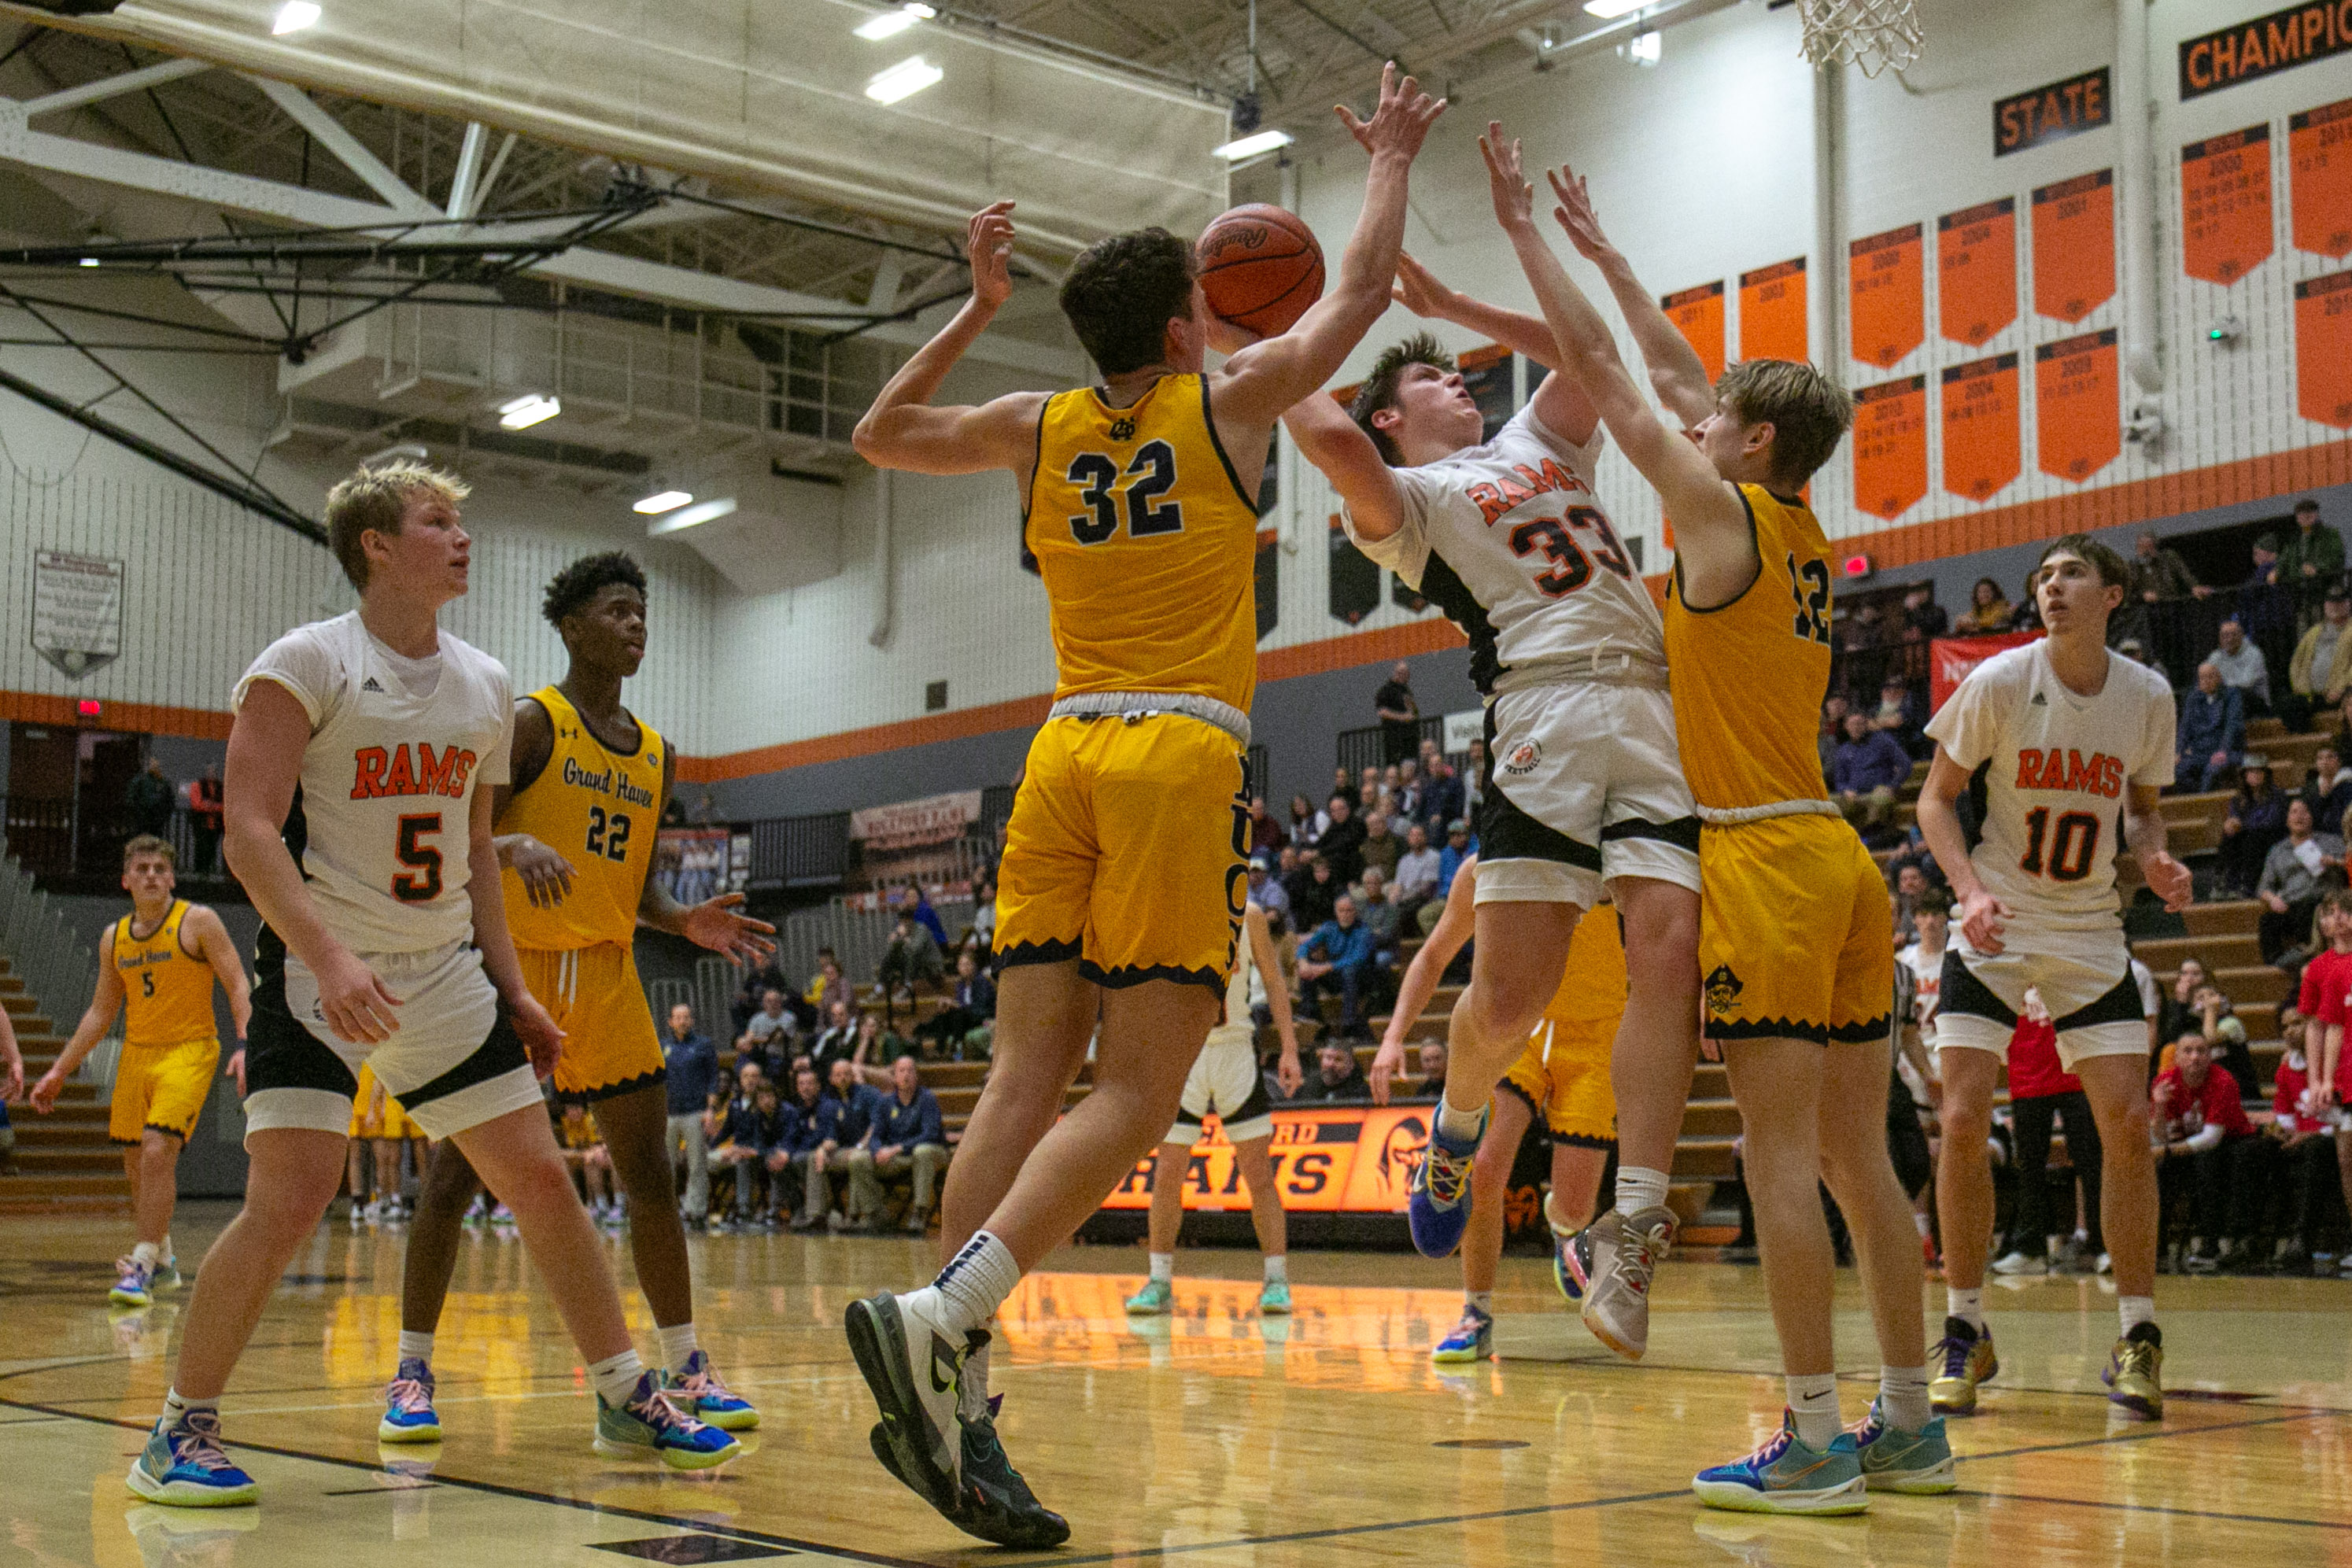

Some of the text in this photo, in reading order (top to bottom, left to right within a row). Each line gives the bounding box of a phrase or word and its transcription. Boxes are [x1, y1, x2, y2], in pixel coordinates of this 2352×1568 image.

[2001, 79, 2102, 148] STATE
[1066, 437, 1184, 548] 32
[1508, 504, 1633, 600] 33
[1786, 549, 1831, 646] 12
[350, 742, 477, 799] RAMS
[563, 756, 612, 795] Grand
[2015, 748, 2125, 799] RAMS
[390, 811, 444, 904] 5
[585, 804, 632, 865] 22
[2018, 805, 2102, 883] 10
[142, 971, 155, 998] 5
